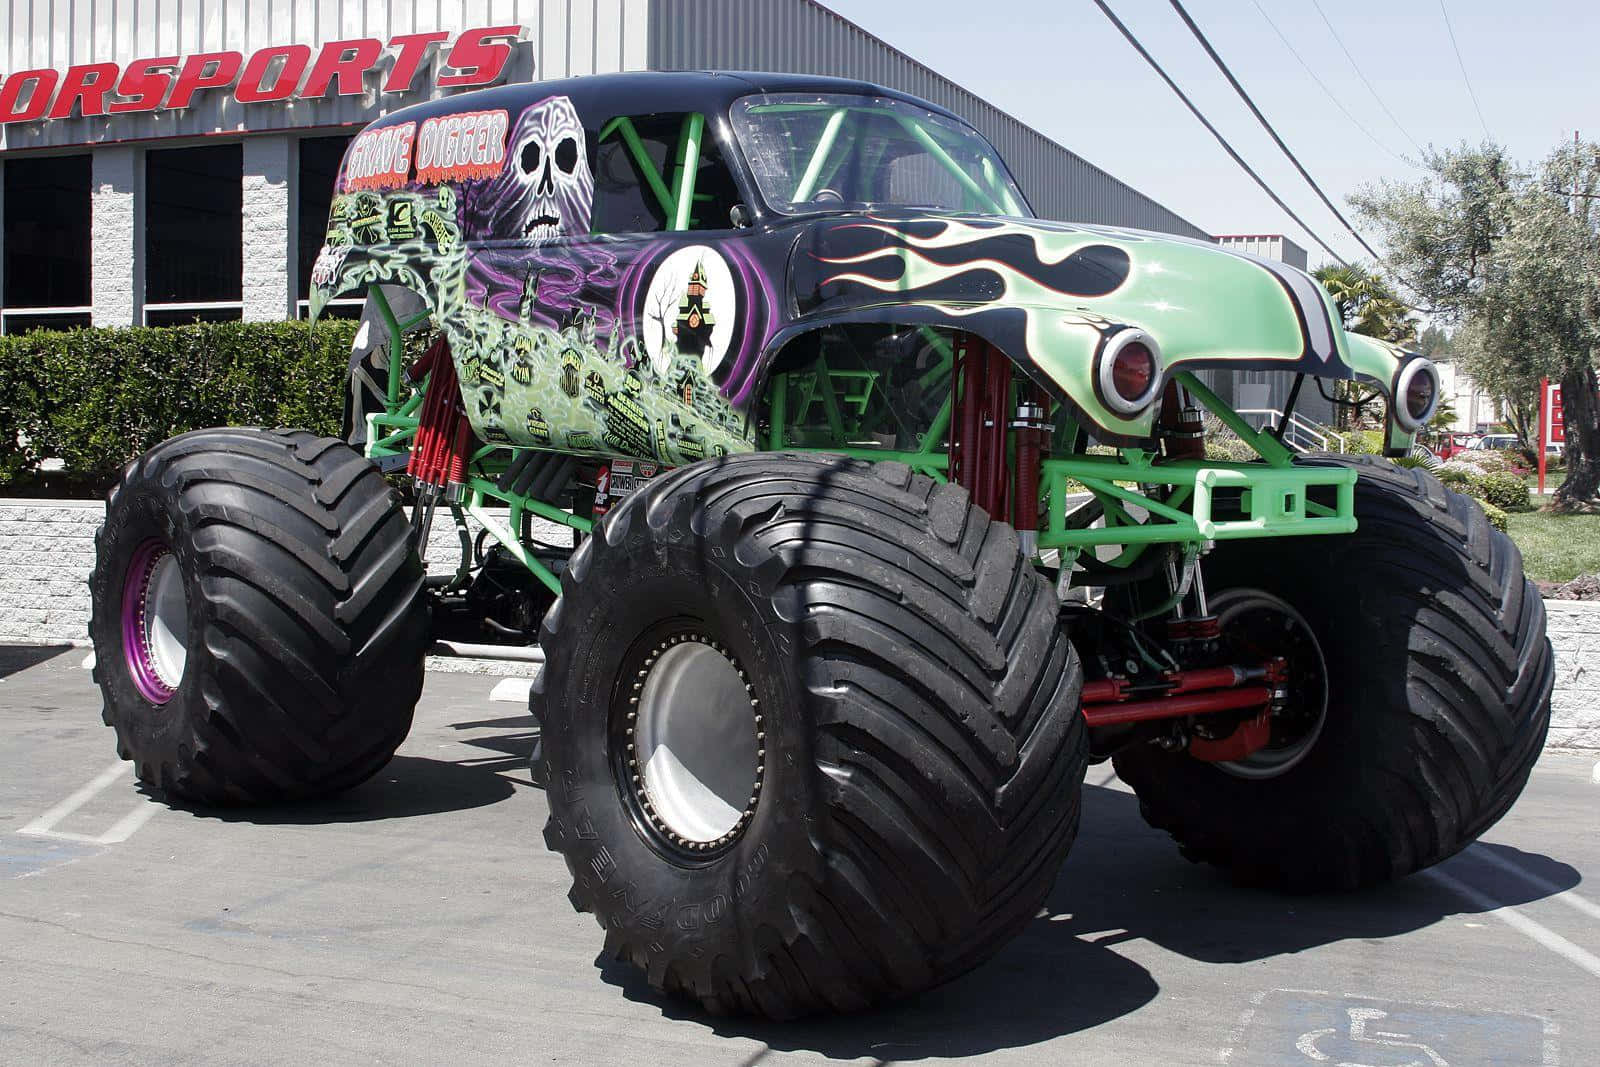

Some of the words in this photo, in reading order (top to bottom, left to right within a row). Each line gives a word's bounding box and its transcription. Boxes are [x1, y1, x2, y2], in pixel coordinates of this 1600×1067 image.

[346, 123, 416, 180] GRAVE
[417, 111, 508, 170] DIGGER
[607, 395, 650, 434] ANDERSON
